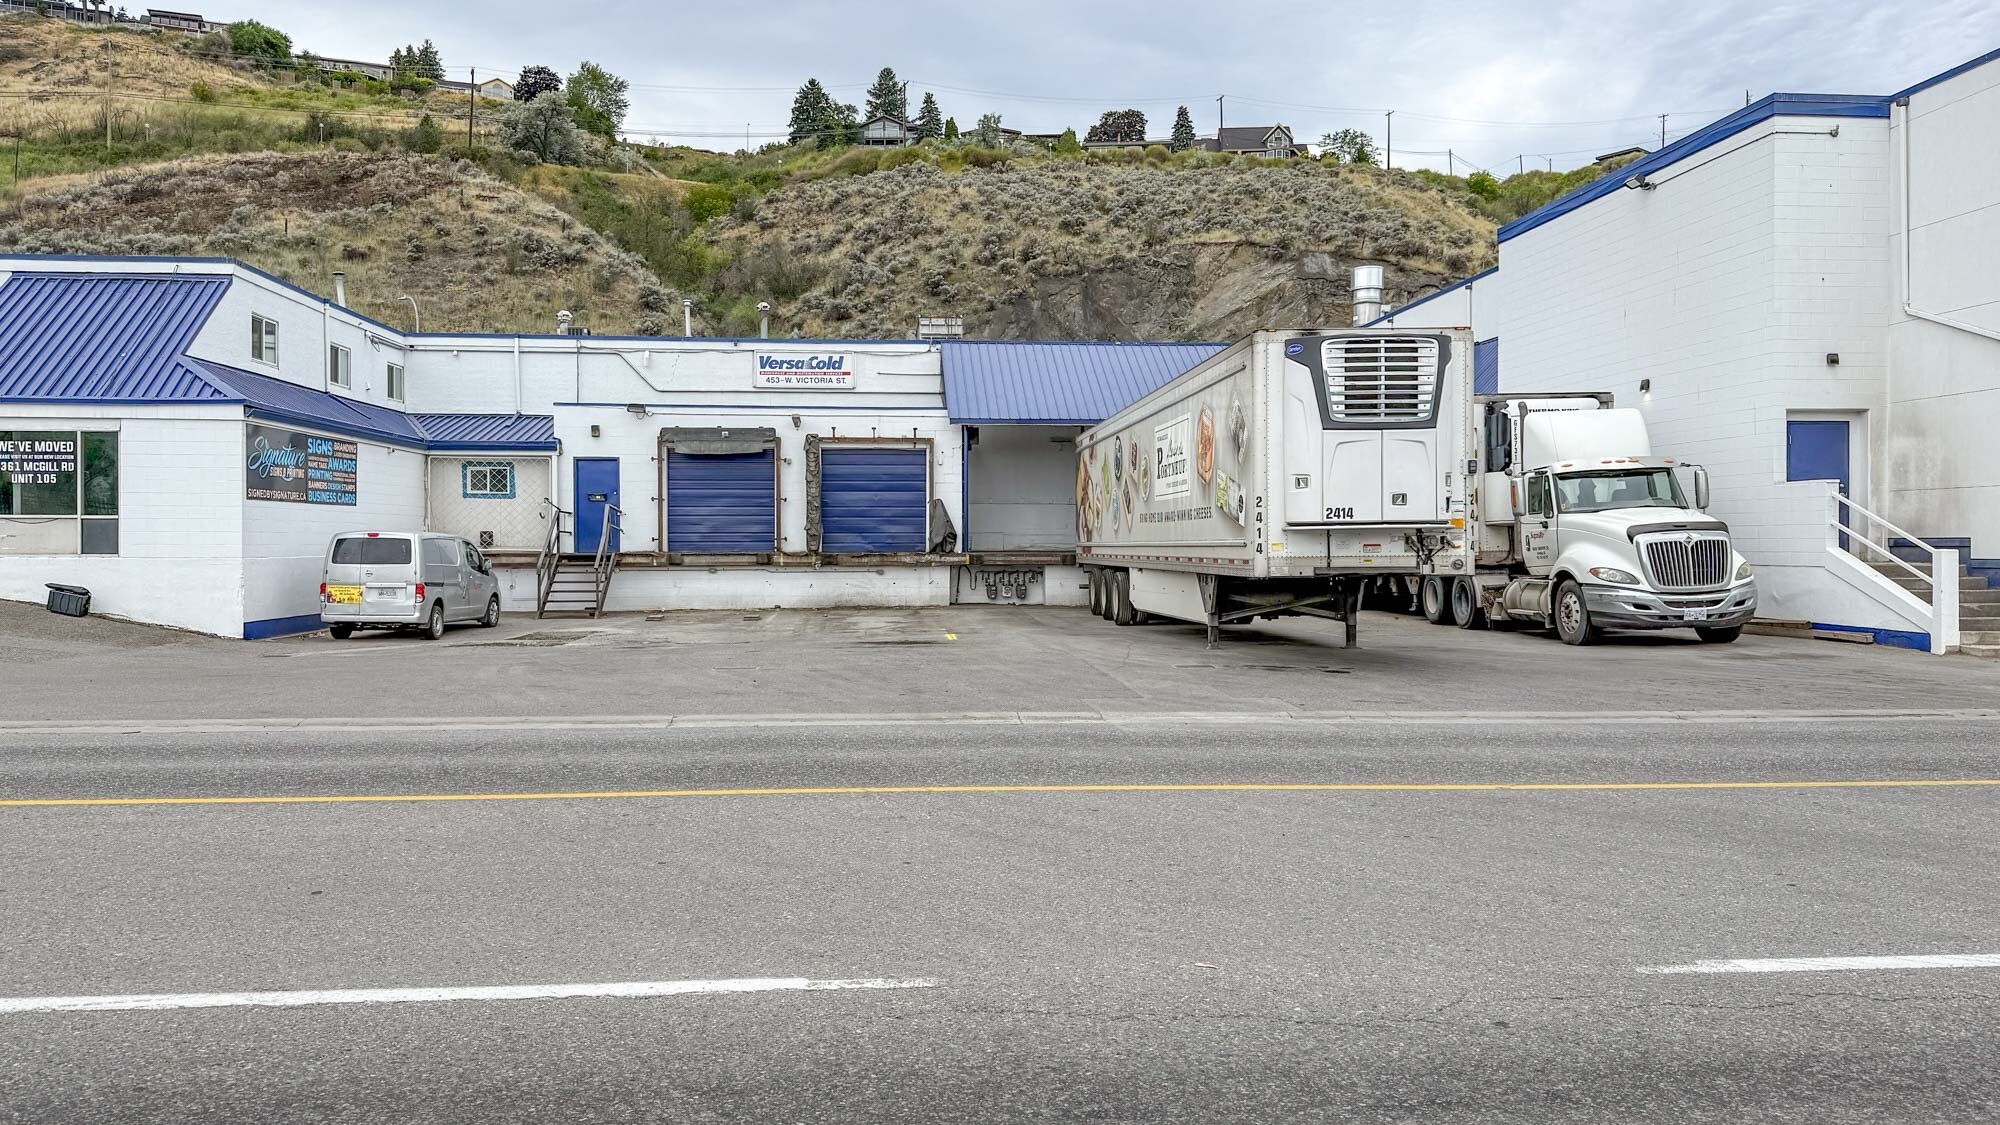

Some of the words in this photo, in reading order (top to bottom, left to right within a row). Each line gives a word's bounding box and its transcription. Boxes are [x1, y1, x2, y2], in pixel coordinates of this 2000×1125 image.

[0, 441, 32, 452] WE'VE
[35, 441, 74, 452] MOVED
[308, 438, 333, 456] SIGNS
[333, 442, 357, 453] BRANDING
[248, 436, 306, 478] Signature
[24, 461, 59, 471] MCGILL
[61, 461, 75, 471] RD
[328, 456, 356, 472] AWARDS
[269, 466, 283, 477] SIGNS
[308, 469, 333, 481] PRINTING
[11, 474, 34, 484] UNIT
[36, 474, 57, 484] 105
[308, 480, 328, 490] BANNERS
[328, 482, 341, 490] DESIGN
[341, 483, 356, 492] STAMPS
[248, 488, 306, 500] SIGNEDBYSIGNATURE.CA
[308, 491, 337, 502] BUSINESS
[337, 493, 356, 504] CARDS
[1325, 507, 1354, 519] 2414
